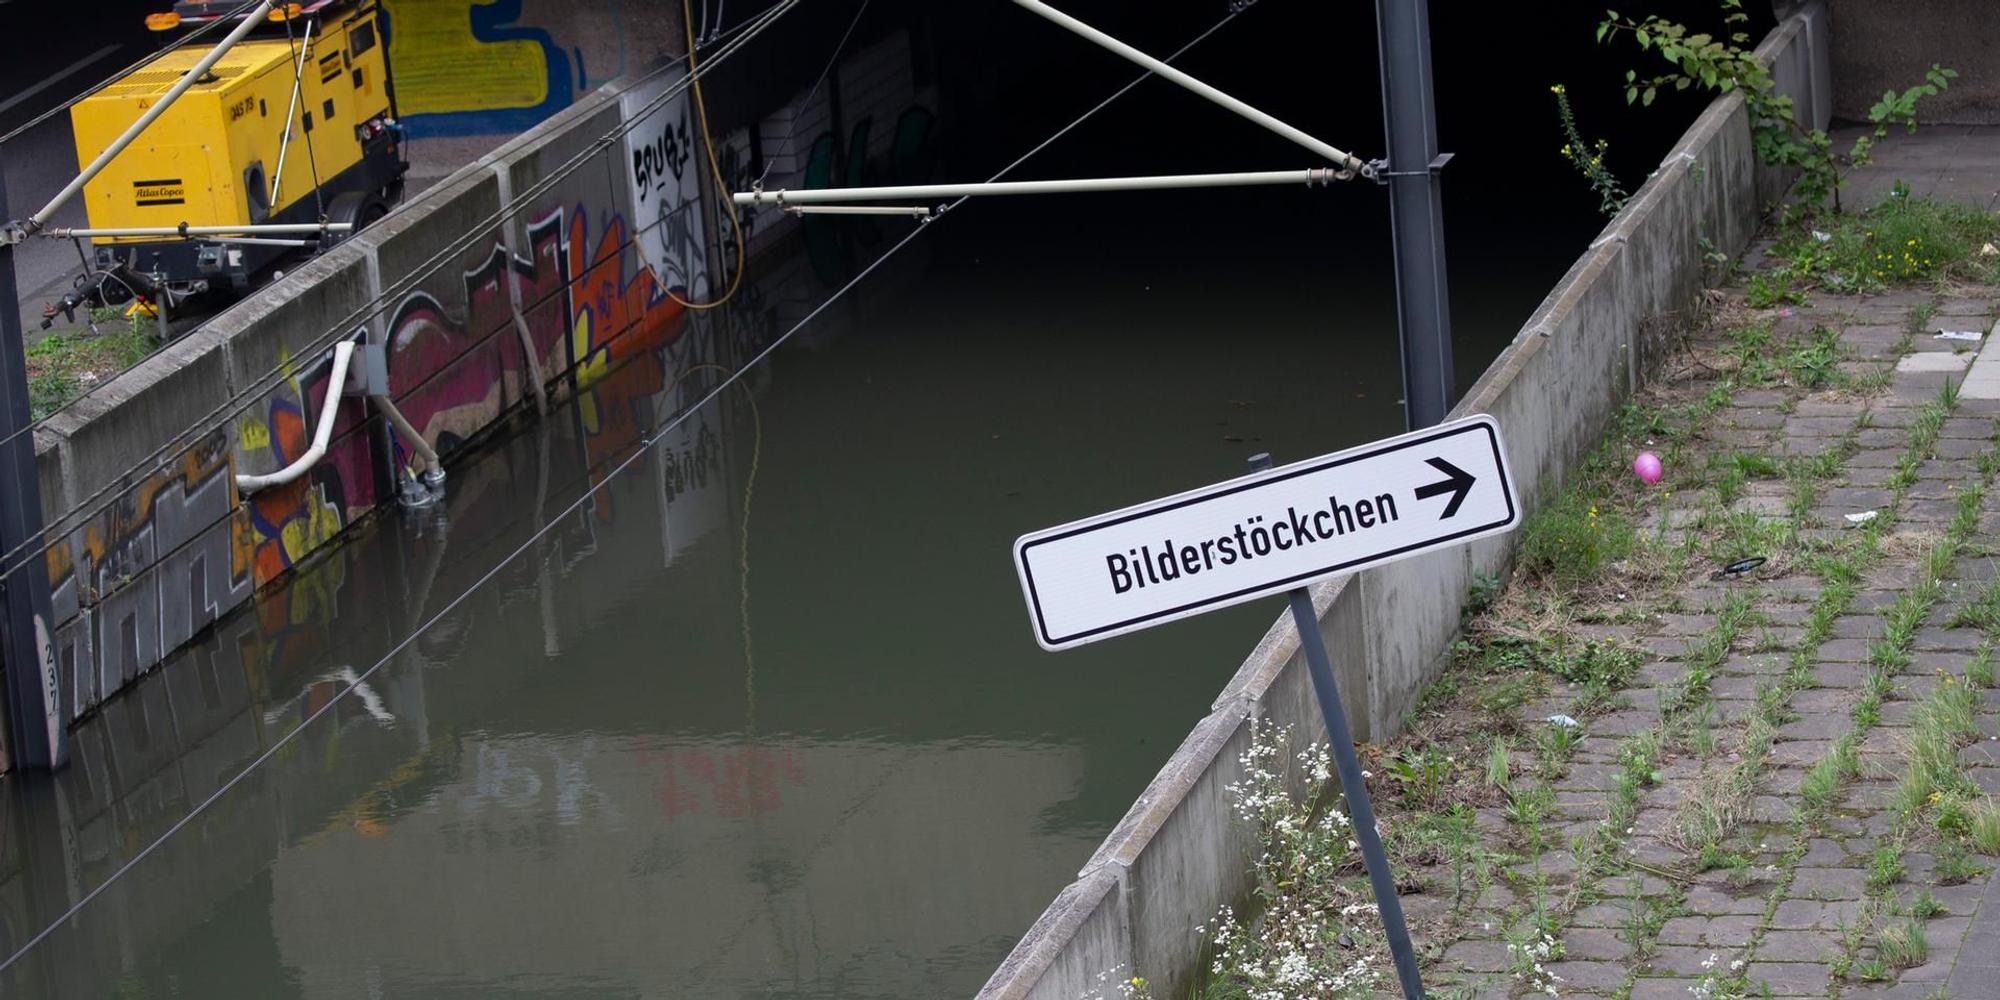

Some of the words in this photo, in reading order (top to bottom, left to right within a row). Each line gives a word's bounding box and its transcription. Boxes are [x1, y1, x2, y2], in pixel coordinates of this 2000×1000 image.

[136, 188, 159, 198] Atlas
[159, 187, 185, 198] Copco
[1106, 492, 1399, 594] Bilderstöckchen
[45, 643, 57, 712] 237
